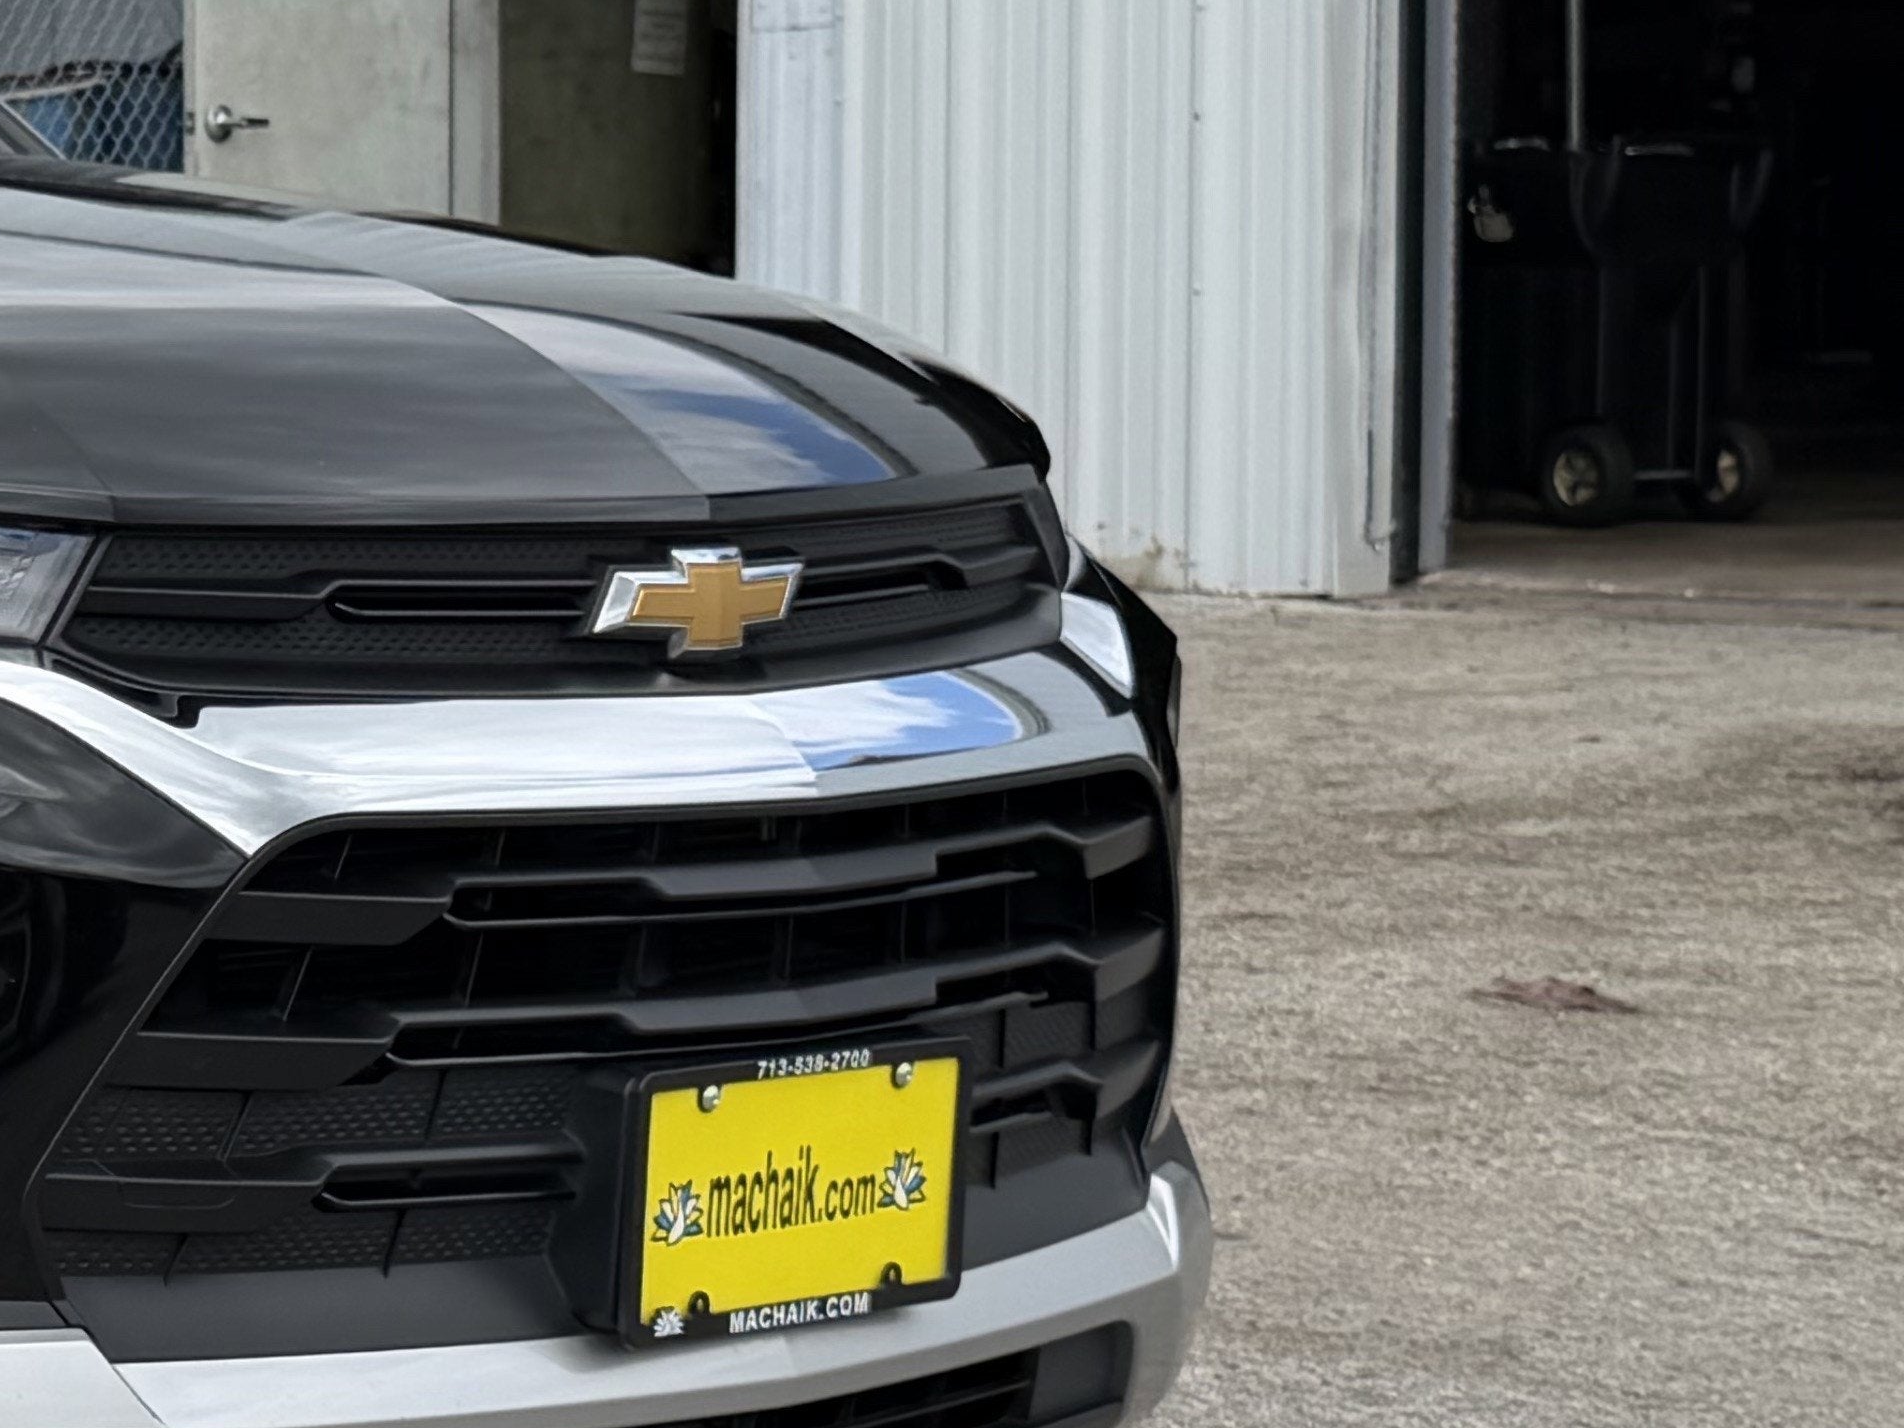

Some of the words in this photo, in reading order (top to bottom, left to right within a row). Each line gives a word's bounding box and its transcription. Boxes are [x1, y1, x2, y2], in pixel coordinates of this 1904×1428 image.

[756, 1048, 871, 1080] 713-538-2700
[705, 1144, 877, 1239] machaik.com
[729, 1292, 871, 1335] MACHAIK.COM
